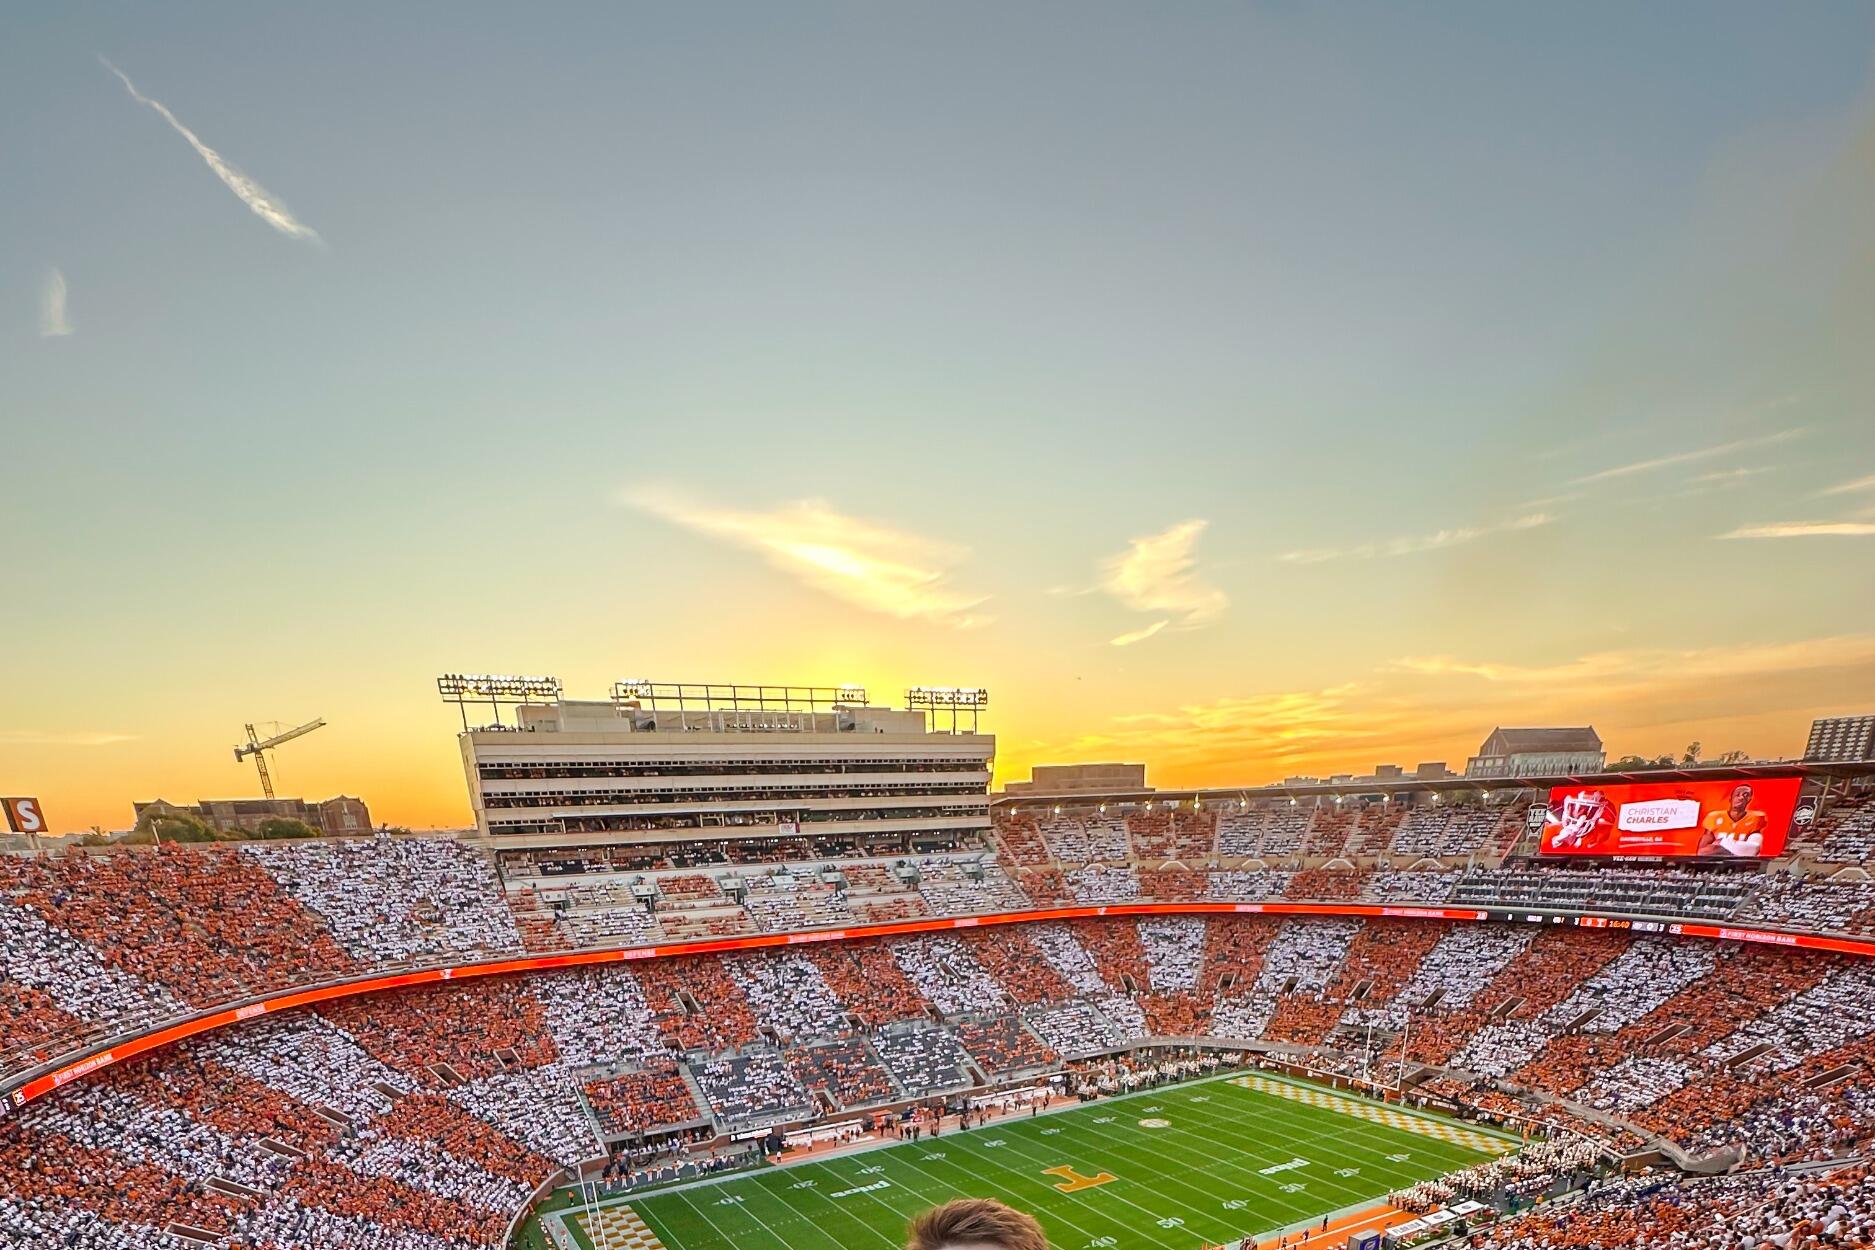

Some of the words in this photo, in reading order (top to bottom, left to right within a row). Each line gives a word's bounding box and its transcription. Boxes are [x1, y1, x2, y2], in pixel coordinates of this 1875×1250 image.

[16, 800, 41, 830] S
[1627, 807, 1678, 816] CHRISTIAN
[1626, 816, 1670, 824] CHARLES
[1609, 920, 1630, 929] 16:40
[1728, 930, 1745, 938] FIRST
[1745, 932, 1775, 941] HORIZON
[1223, 1199, 1248, 1210] 40
[1156, 1216, 1185, 1229] 50
[1091, 1235, 1118, 1248] 40
